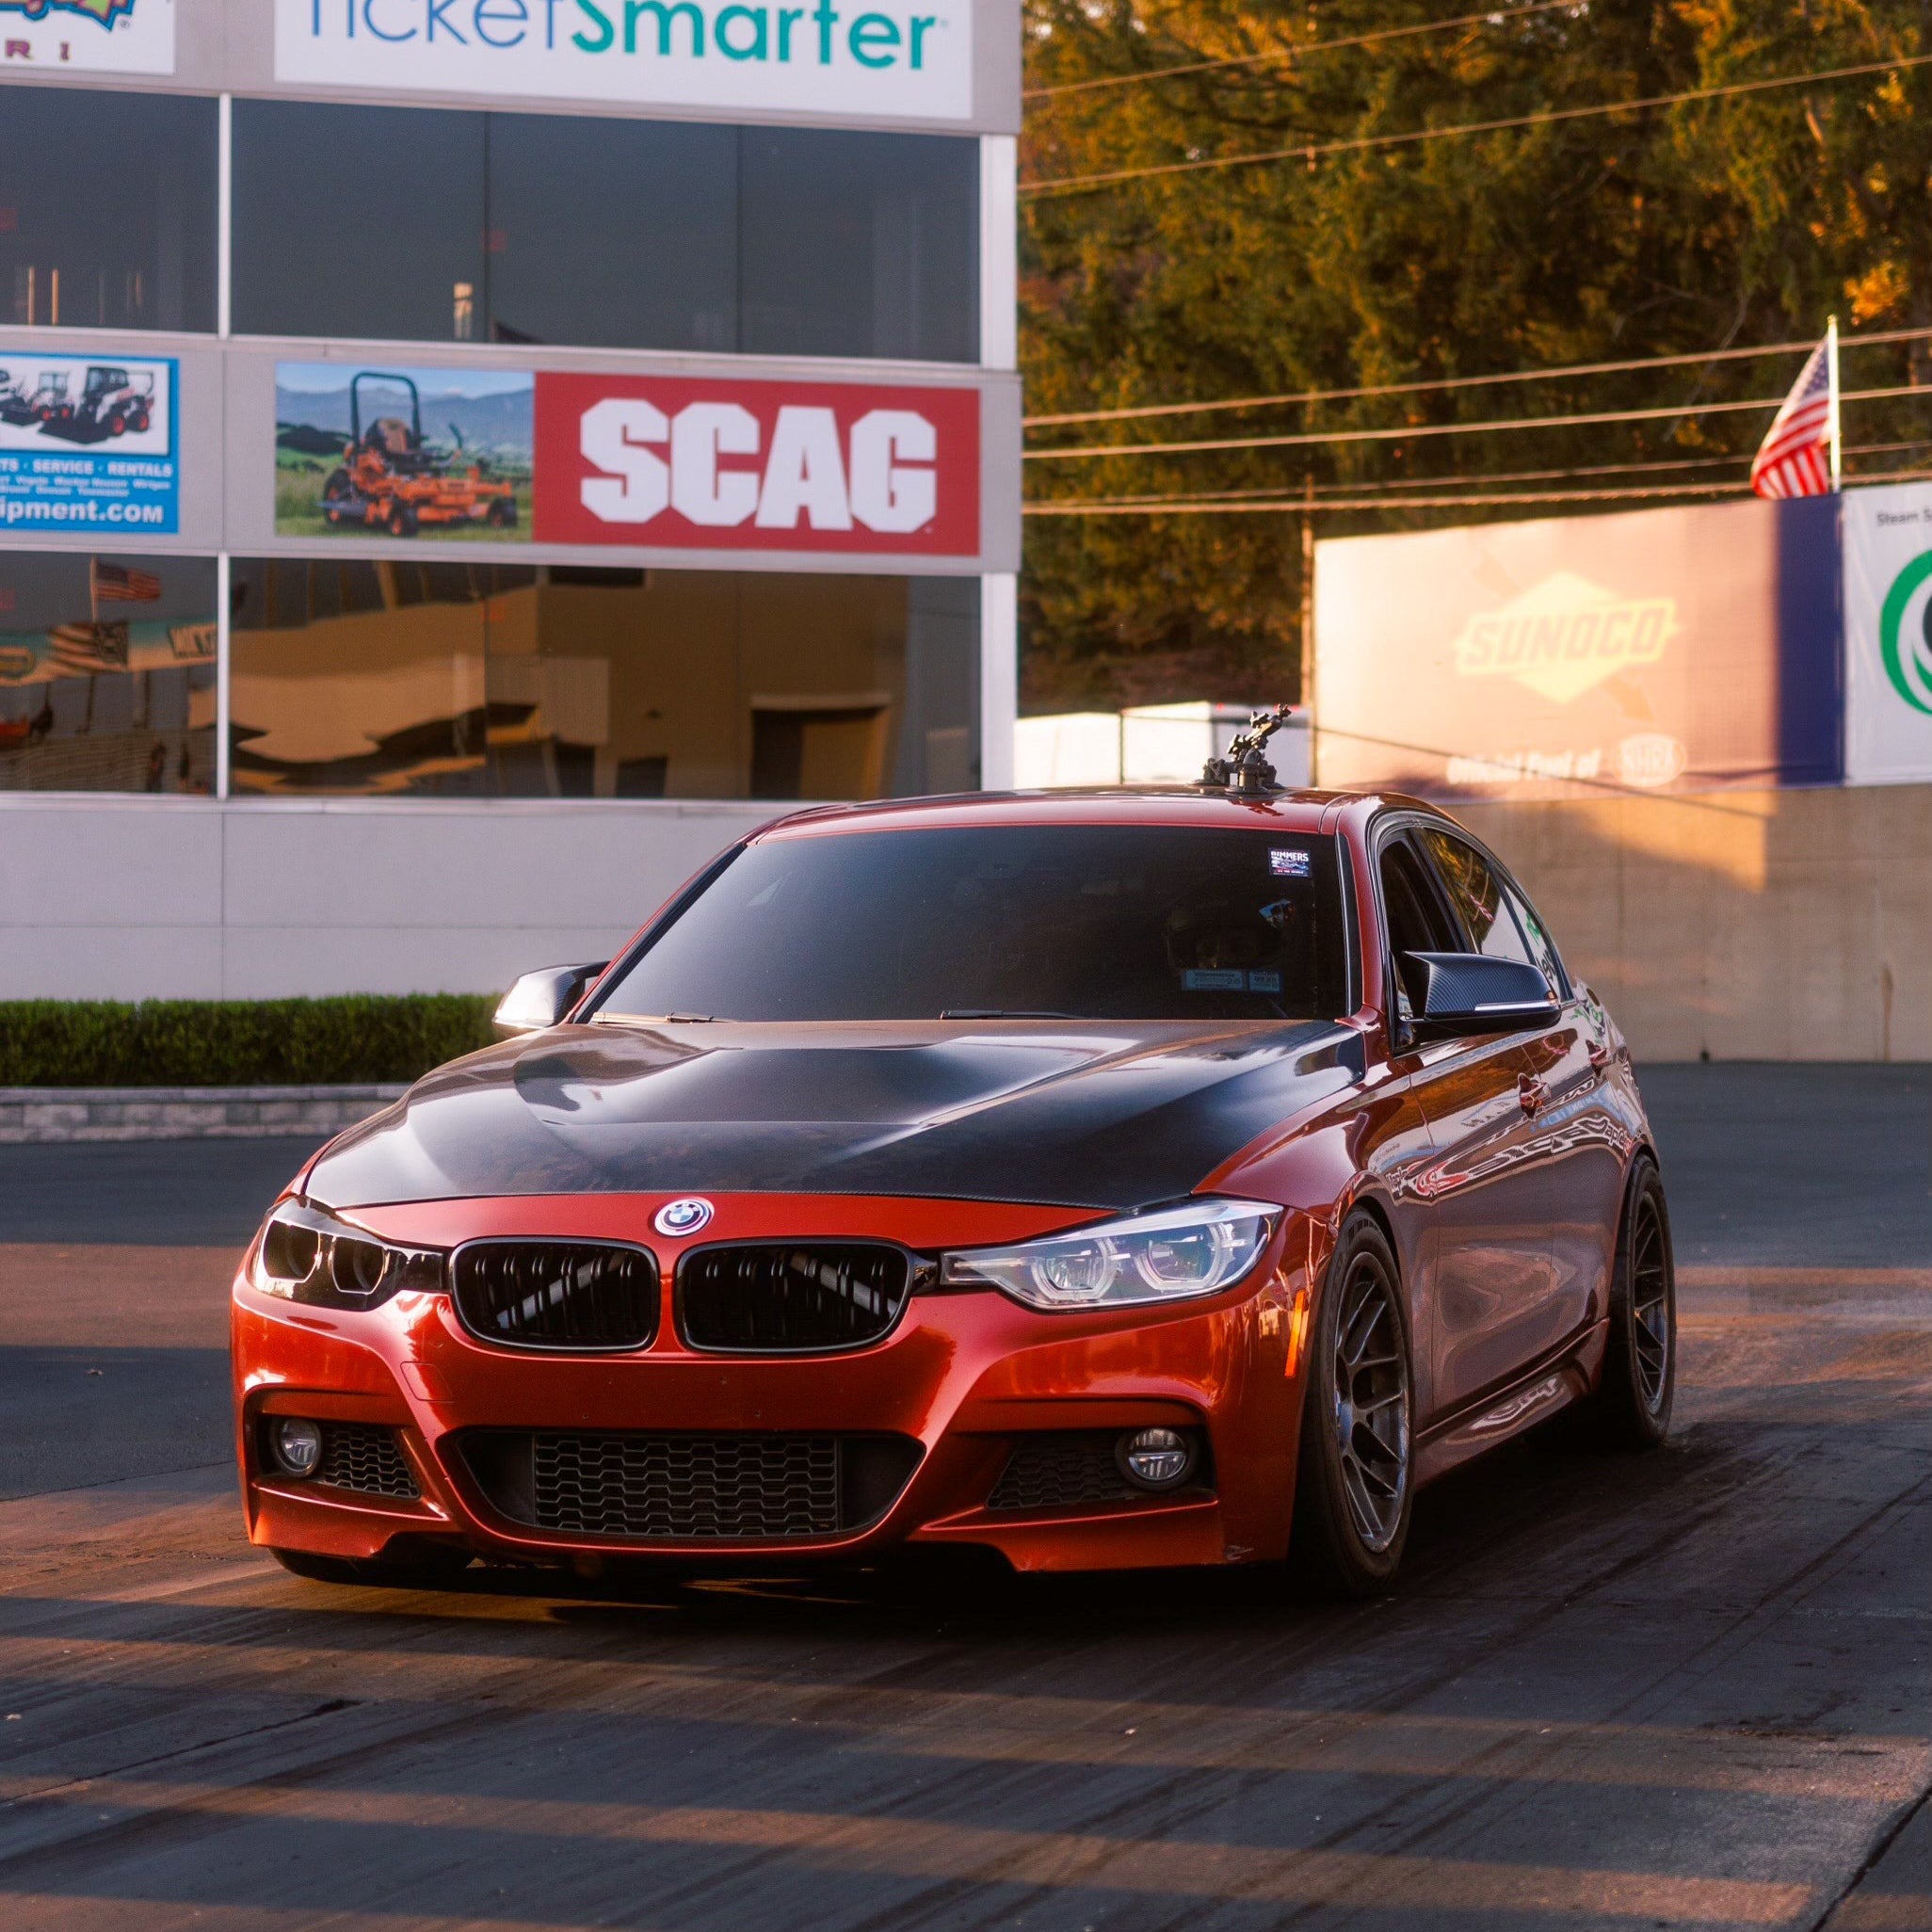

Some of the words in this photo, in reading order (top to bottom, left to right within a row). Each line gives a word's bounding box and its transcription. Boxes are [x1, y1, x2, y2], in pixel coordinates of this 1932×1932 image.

[33, 459, 93, 475] SERVICE
[107, 461, 173, 477] RENTALS
[580, 397, 937, 534] SCAG
[1464, 607, 1666, 665] SUNOCO
